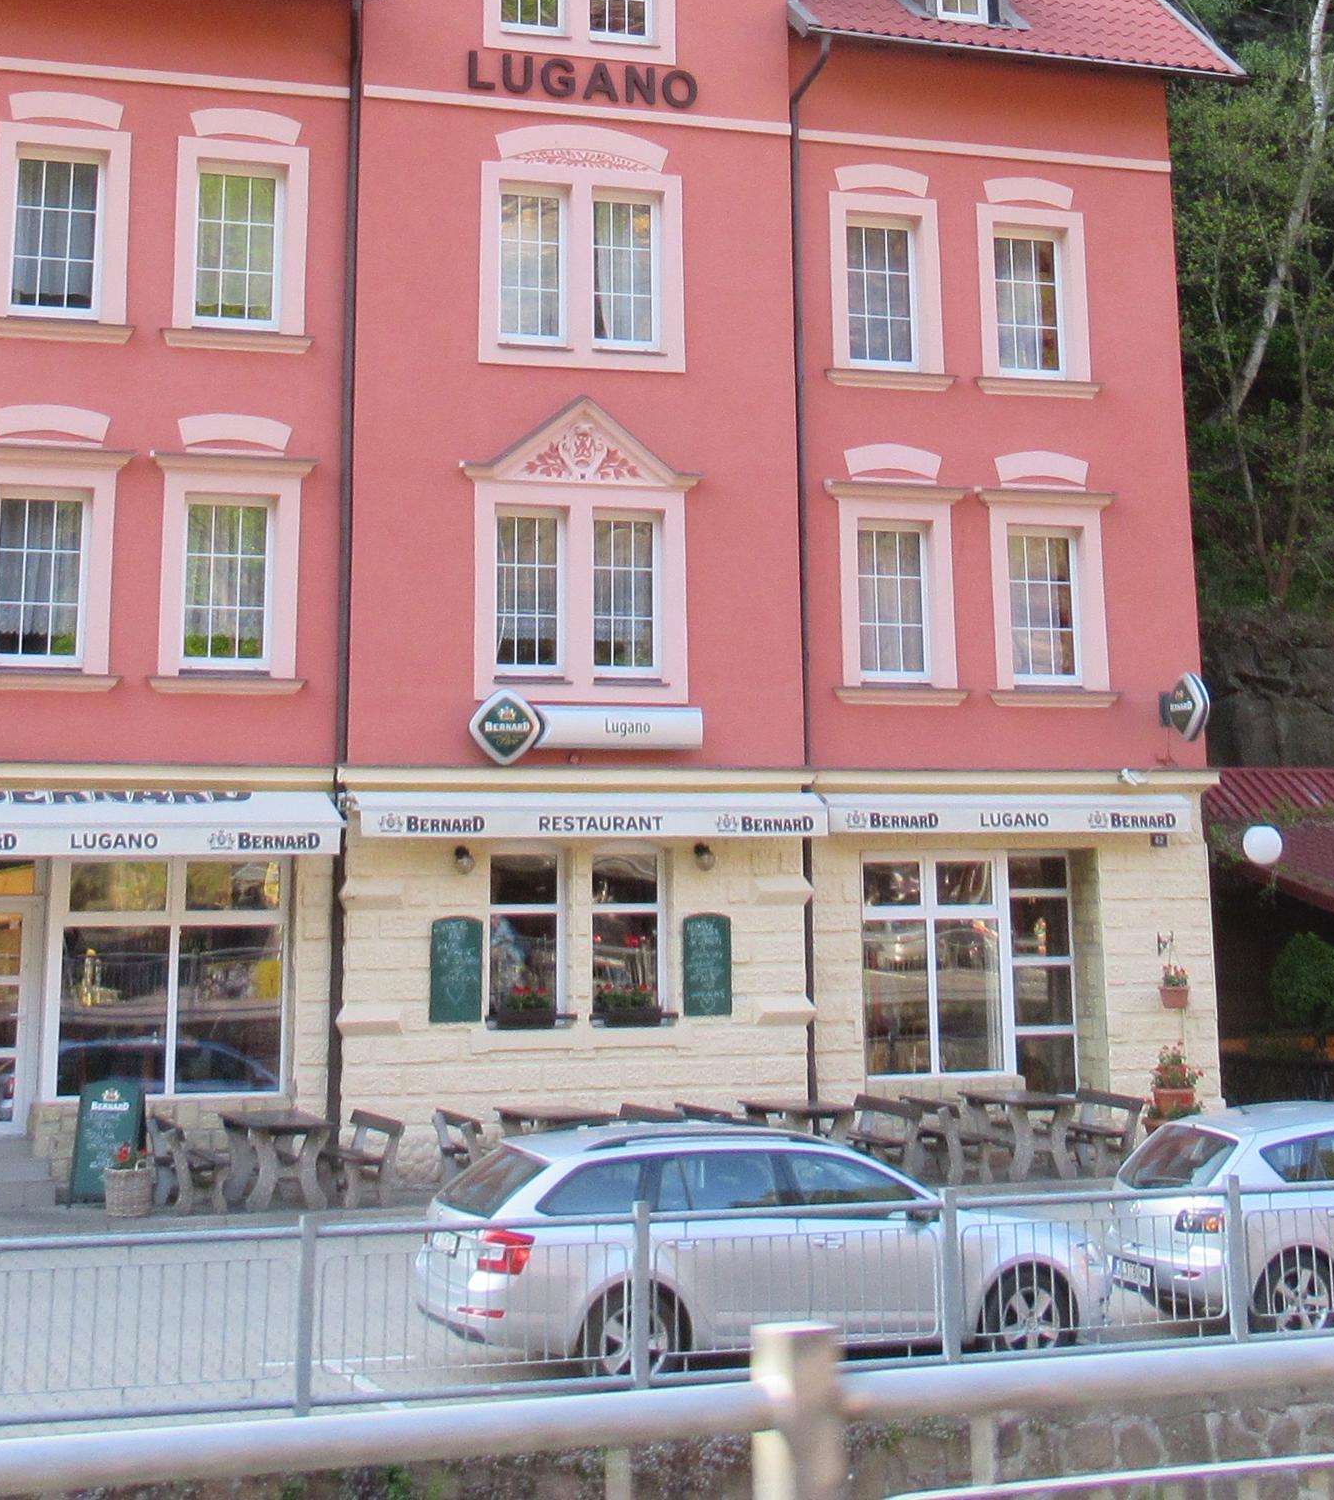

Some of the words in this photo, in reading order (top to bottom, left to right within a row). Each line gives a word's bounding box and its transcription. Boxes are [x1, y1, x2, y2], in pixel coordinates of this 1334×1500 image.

[468, 51, 698, 108] LUGANO
[484, 719, 530, 733] BERNARD
[605, 718, 651, 736] Lugano
[406, 815, 485, 832] BERNARD
[538, 816, 664, 832] RESTAURANT
[740, 815, 814, 832] BERNARD
[869, 813, 939, 829] BERNARD
[980, 813, 1049, 827] LUGANO
[1110, 813, 1176, 829] BERNARD
[70, 833, 158, 850] LUGANO
[237, 833, 321, 851] BERNARD
[91, 1101, 129, 1112] BERNARD
